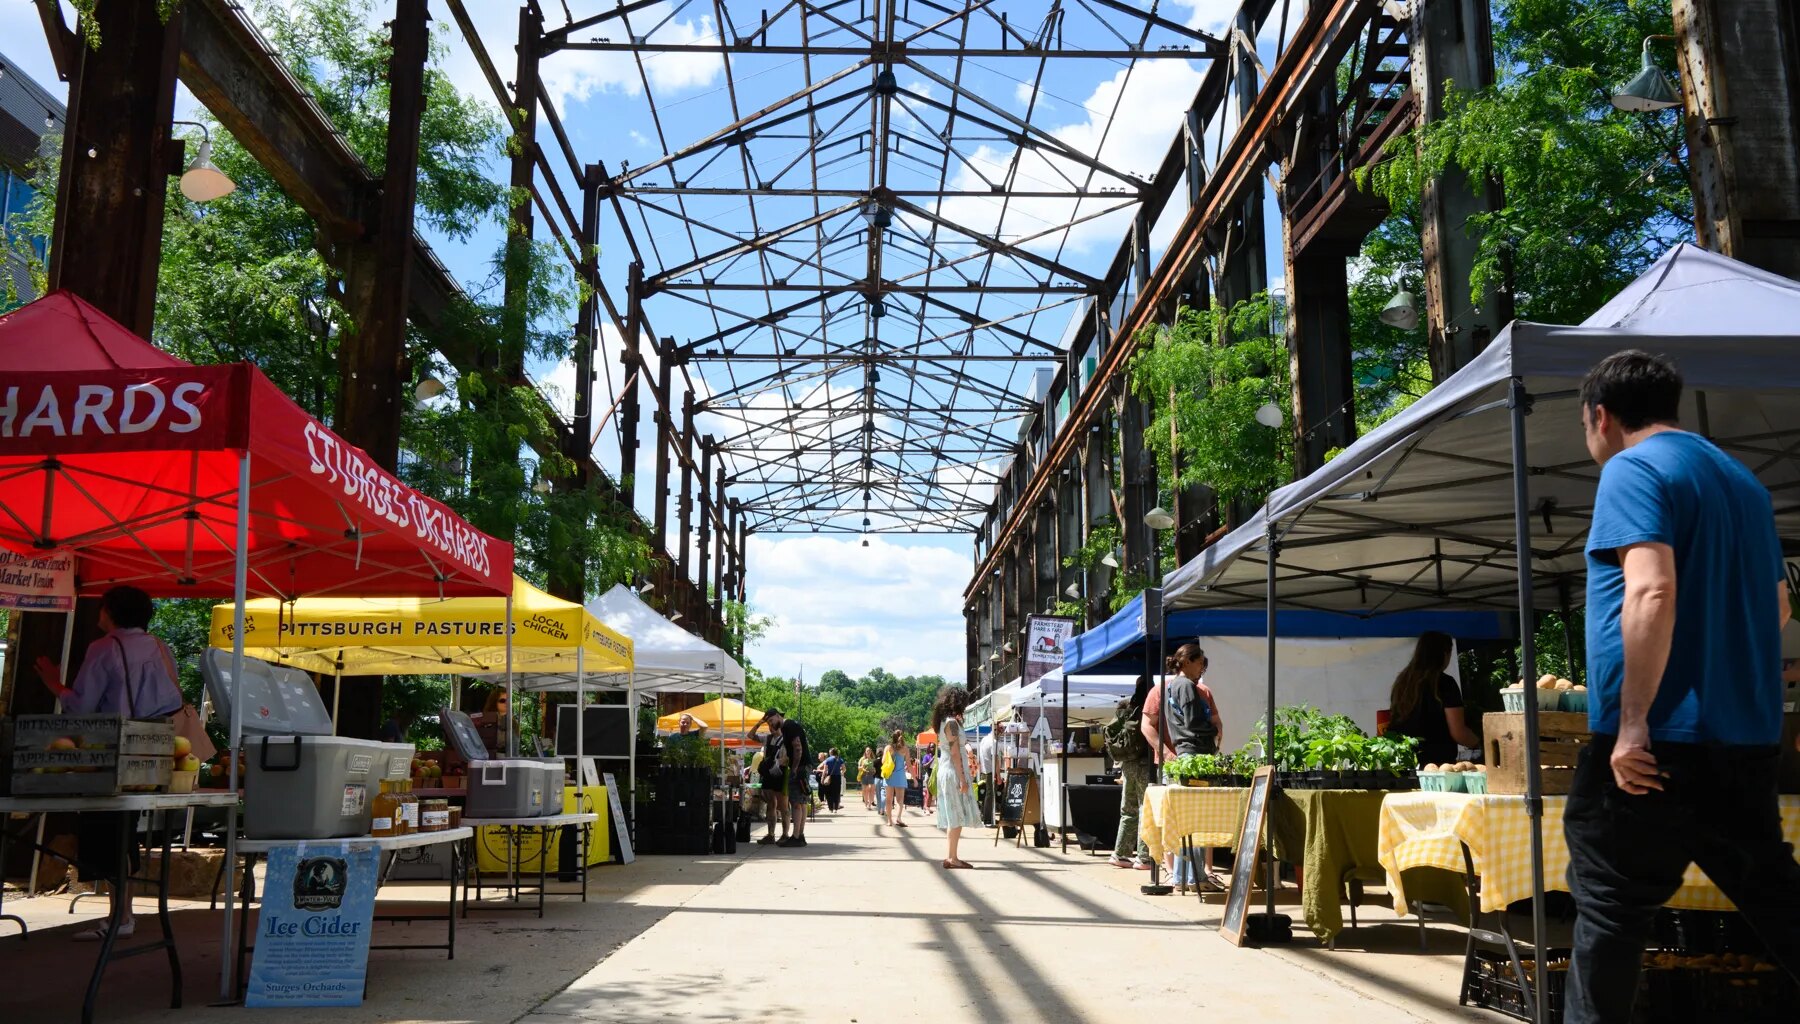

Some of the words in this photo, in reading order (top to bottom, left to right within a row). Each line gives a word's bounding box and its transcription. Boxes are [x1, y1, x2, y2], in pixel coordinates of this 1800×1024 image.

[304, 421, 410, 528] STURGES
[408, 494, 490, 577] ORCHARDS
[221, 615, 254, 635] FRH
[277, 622, 402, 636] PITTSBURGH
[523, 620, 569, 641] CHICKEN
[532, 613, 565, 631] LOCAL
[227, 623, 255, 641] EGS
[267, 915, 298, 936] Ice
[303, 914, 360, 936] Cider
[303, 982, 346, 991] Orchards
